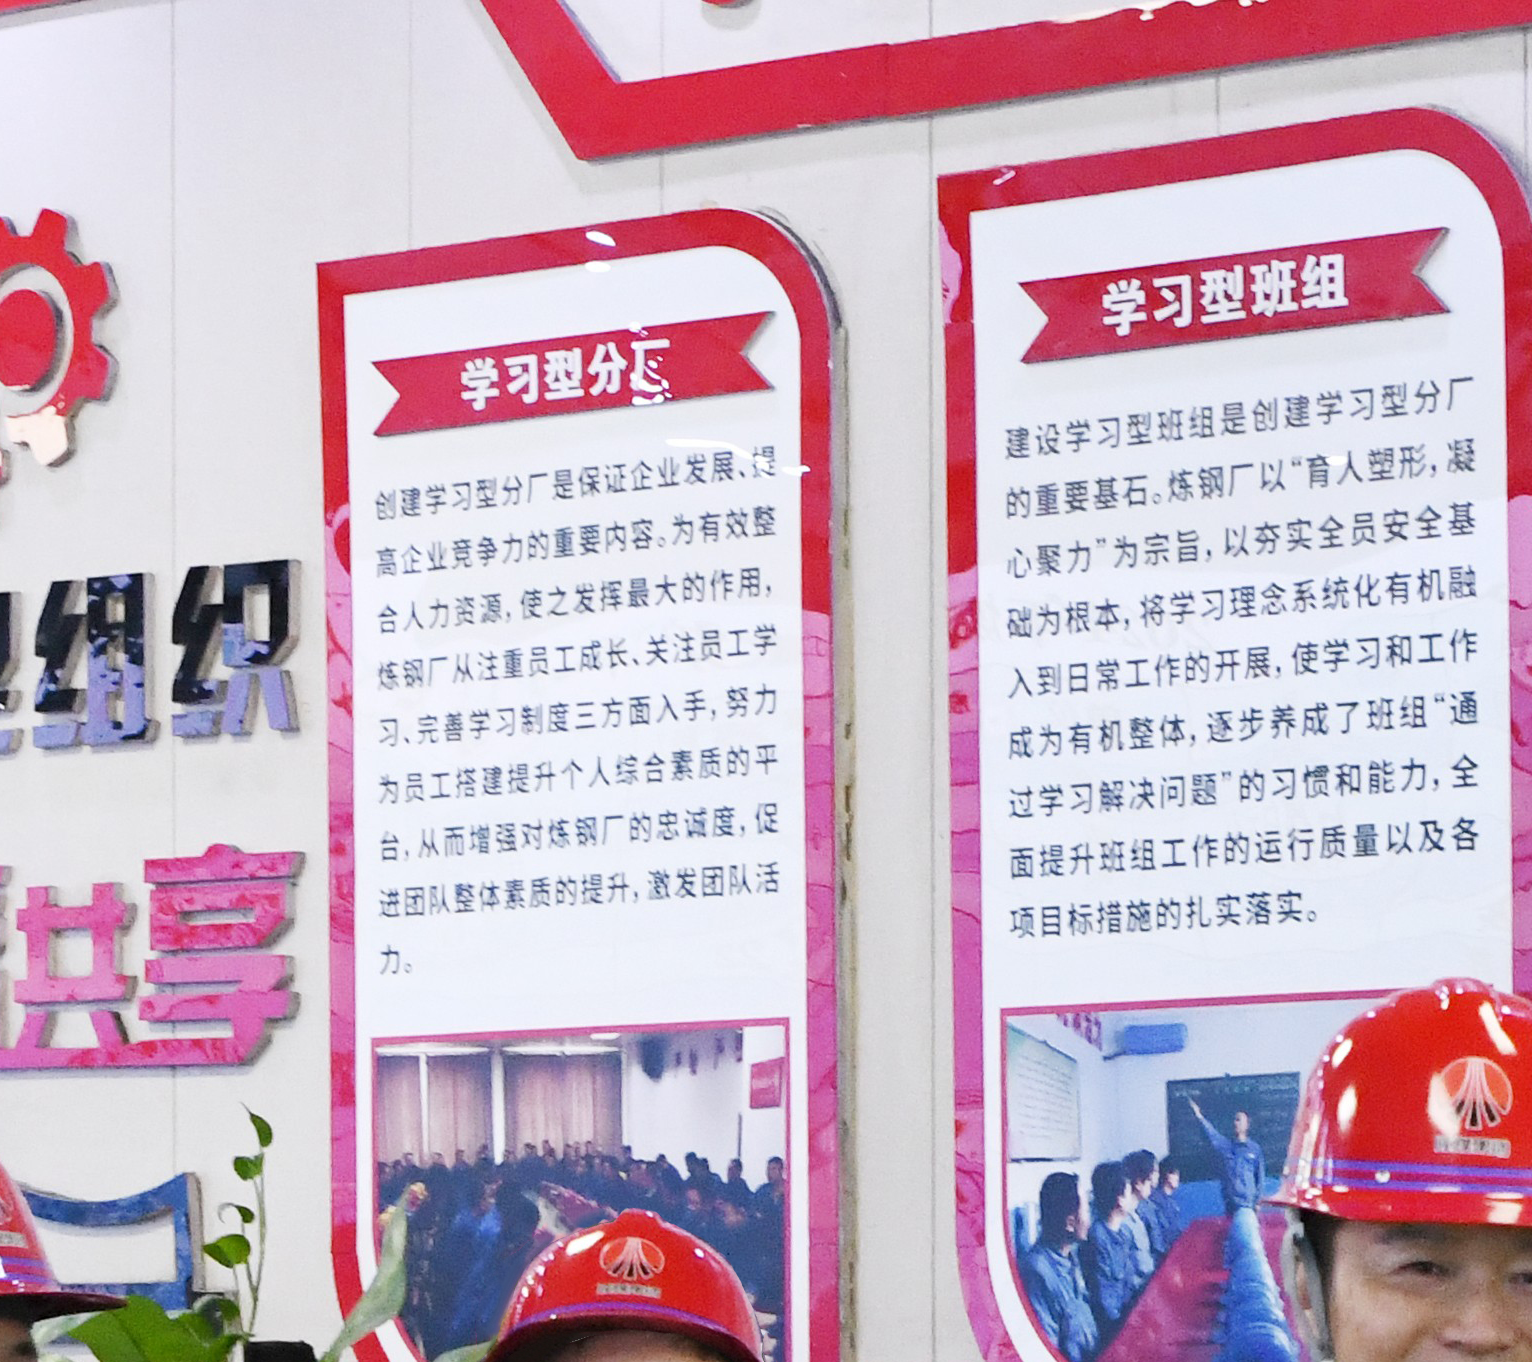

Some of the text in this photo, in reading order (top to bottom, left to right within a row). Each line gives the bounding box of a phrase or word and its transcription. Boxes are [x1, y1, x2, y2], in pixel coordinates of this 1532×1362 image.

[1101, 253, 1350, 336] 学习型班组
[460, 338, 672, 411] 学习型分厂
[380, 946, 414, 975] 力。
